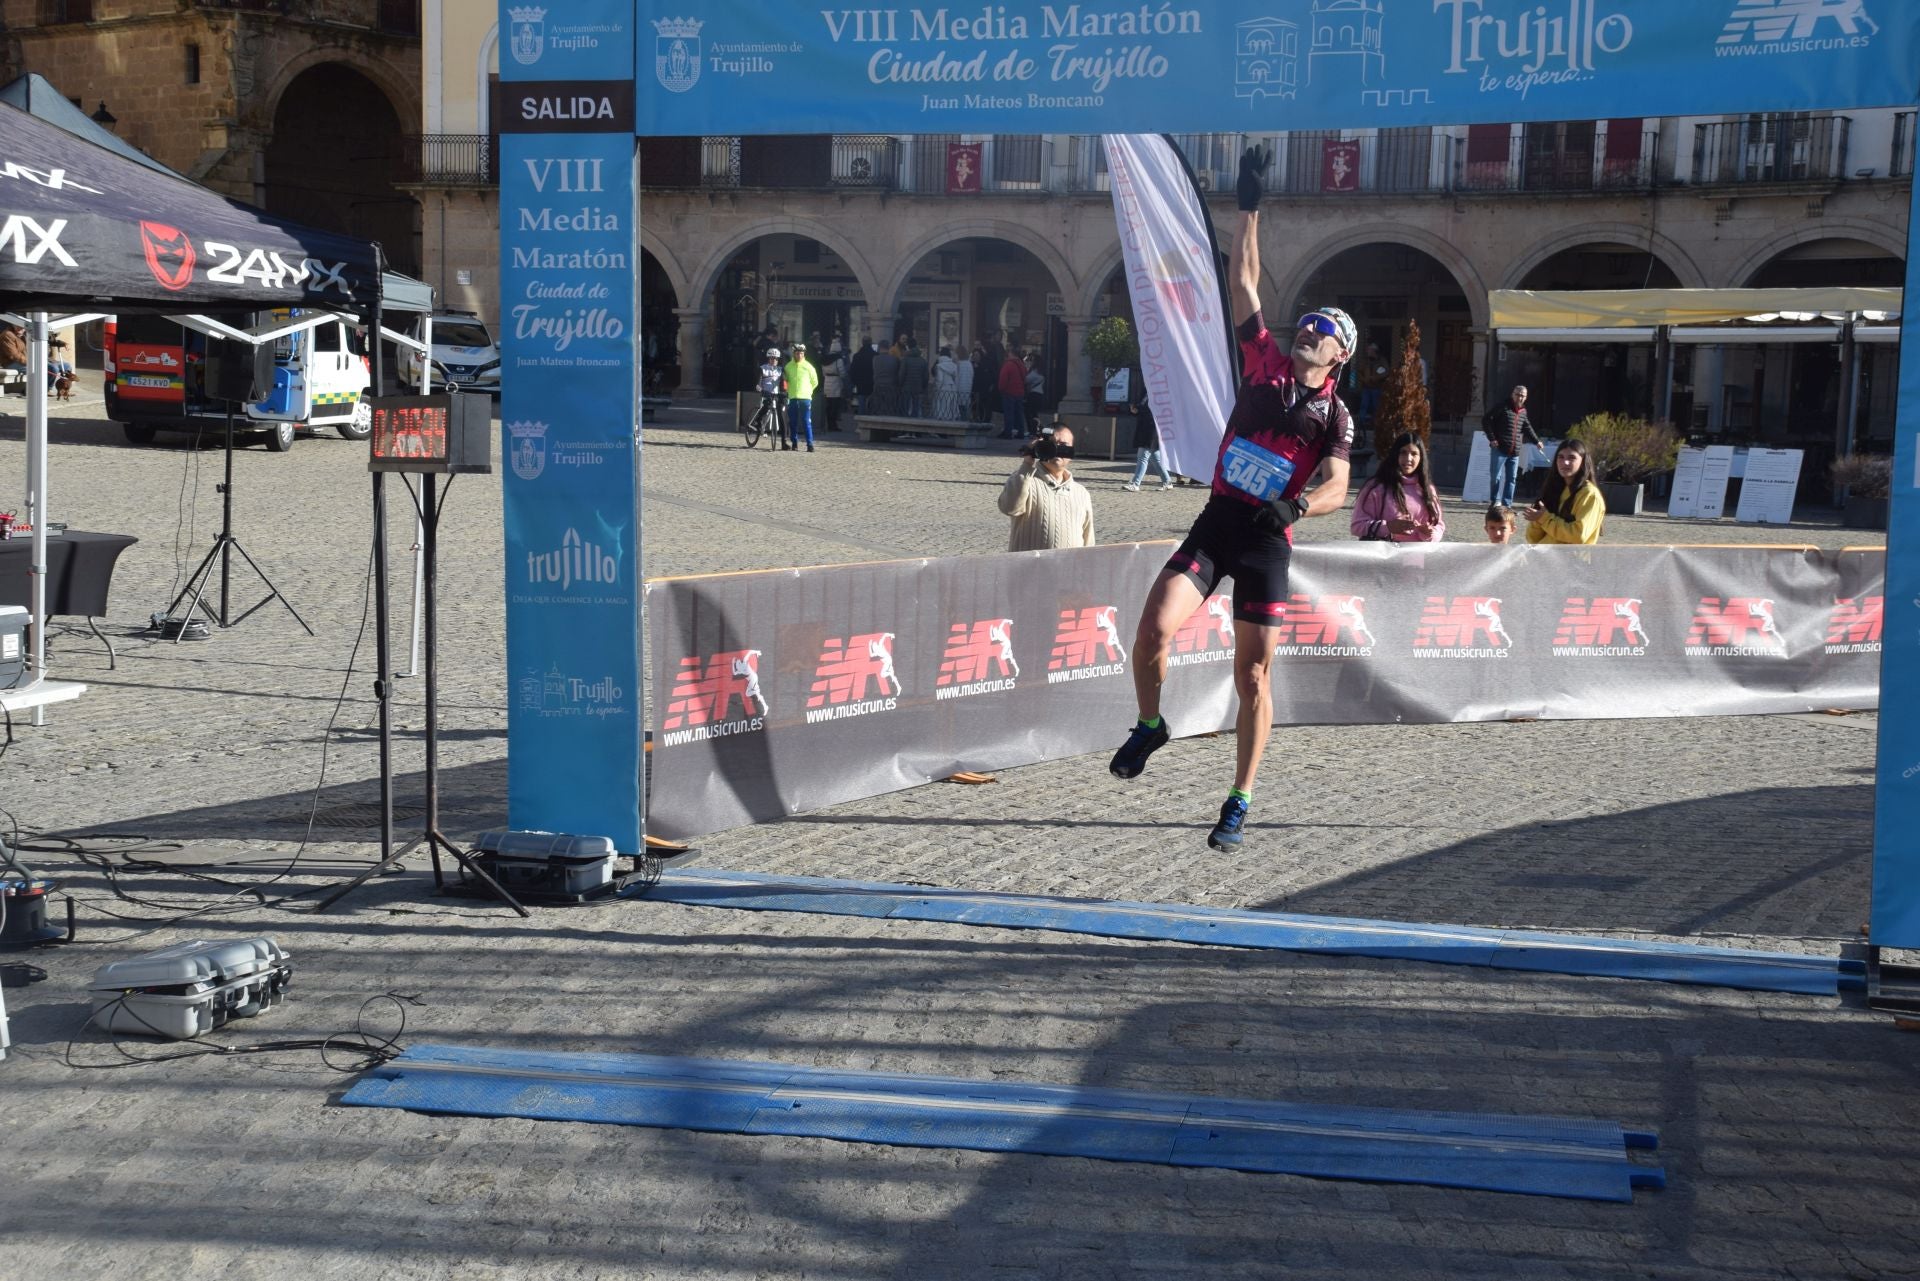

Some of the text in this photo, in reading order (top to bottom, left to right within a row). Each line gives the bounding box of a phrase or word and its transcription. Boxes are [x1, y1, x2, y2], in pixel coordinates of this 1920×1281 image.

[550, 22, 623, 37] Ayuntamiento de
[822, 3, 1204, 43] VIII Media Maratón
[549, 35, 599, 51] Trujillo
[1432, 0, 1634, 75] Trujillo
[1714, 35, 1870, 57] www.musicrun.es
[711, 41, 804, 58] Ayuntamiento de
[710, 55, 775, 76] Trujillo
[868, 37, 1169, 92] Ciudad de Trujillo
[1479, 64, 1501, 92] te
[521, 97, 615, 121] SALIDA
[922, 92, 1105, 113] Juan Mateos Broncano
[522, 158, 605, 193] VIII
[518, 207, 620, 232] Media
[512, 246, 627, 270] Maratón
[525, 279, 611, 299] Ciudad de
[511, 303, 625, 352] Trujillo
[516, 356, 621, 368] Juan Mateos Broncano
[133, 377, 151, 386] 4521
[553, 440, 627, 452] Ayuntamiento de
[551, 452, 603, 469] Trujillo
[1226, 455, 1272, 498] 545
[527, 526, 617, 592] trujillo
[1167, 648, 1236, 667] ww.musicrun.es
[1413, 646, 1509, 659] www.musicrun.es
[1552, 644, 1646, 658] www.musicrun.es
[1047, 662, 1125, 685] www.musicrun.es
[567, 676, 623, 704] Trujillo
[936, 676, 1016, 701] www.musicrun.es
[806, 697, 897, 725] www.musicrun.es
[663, 716, 764, 748] www.musicrun.es
